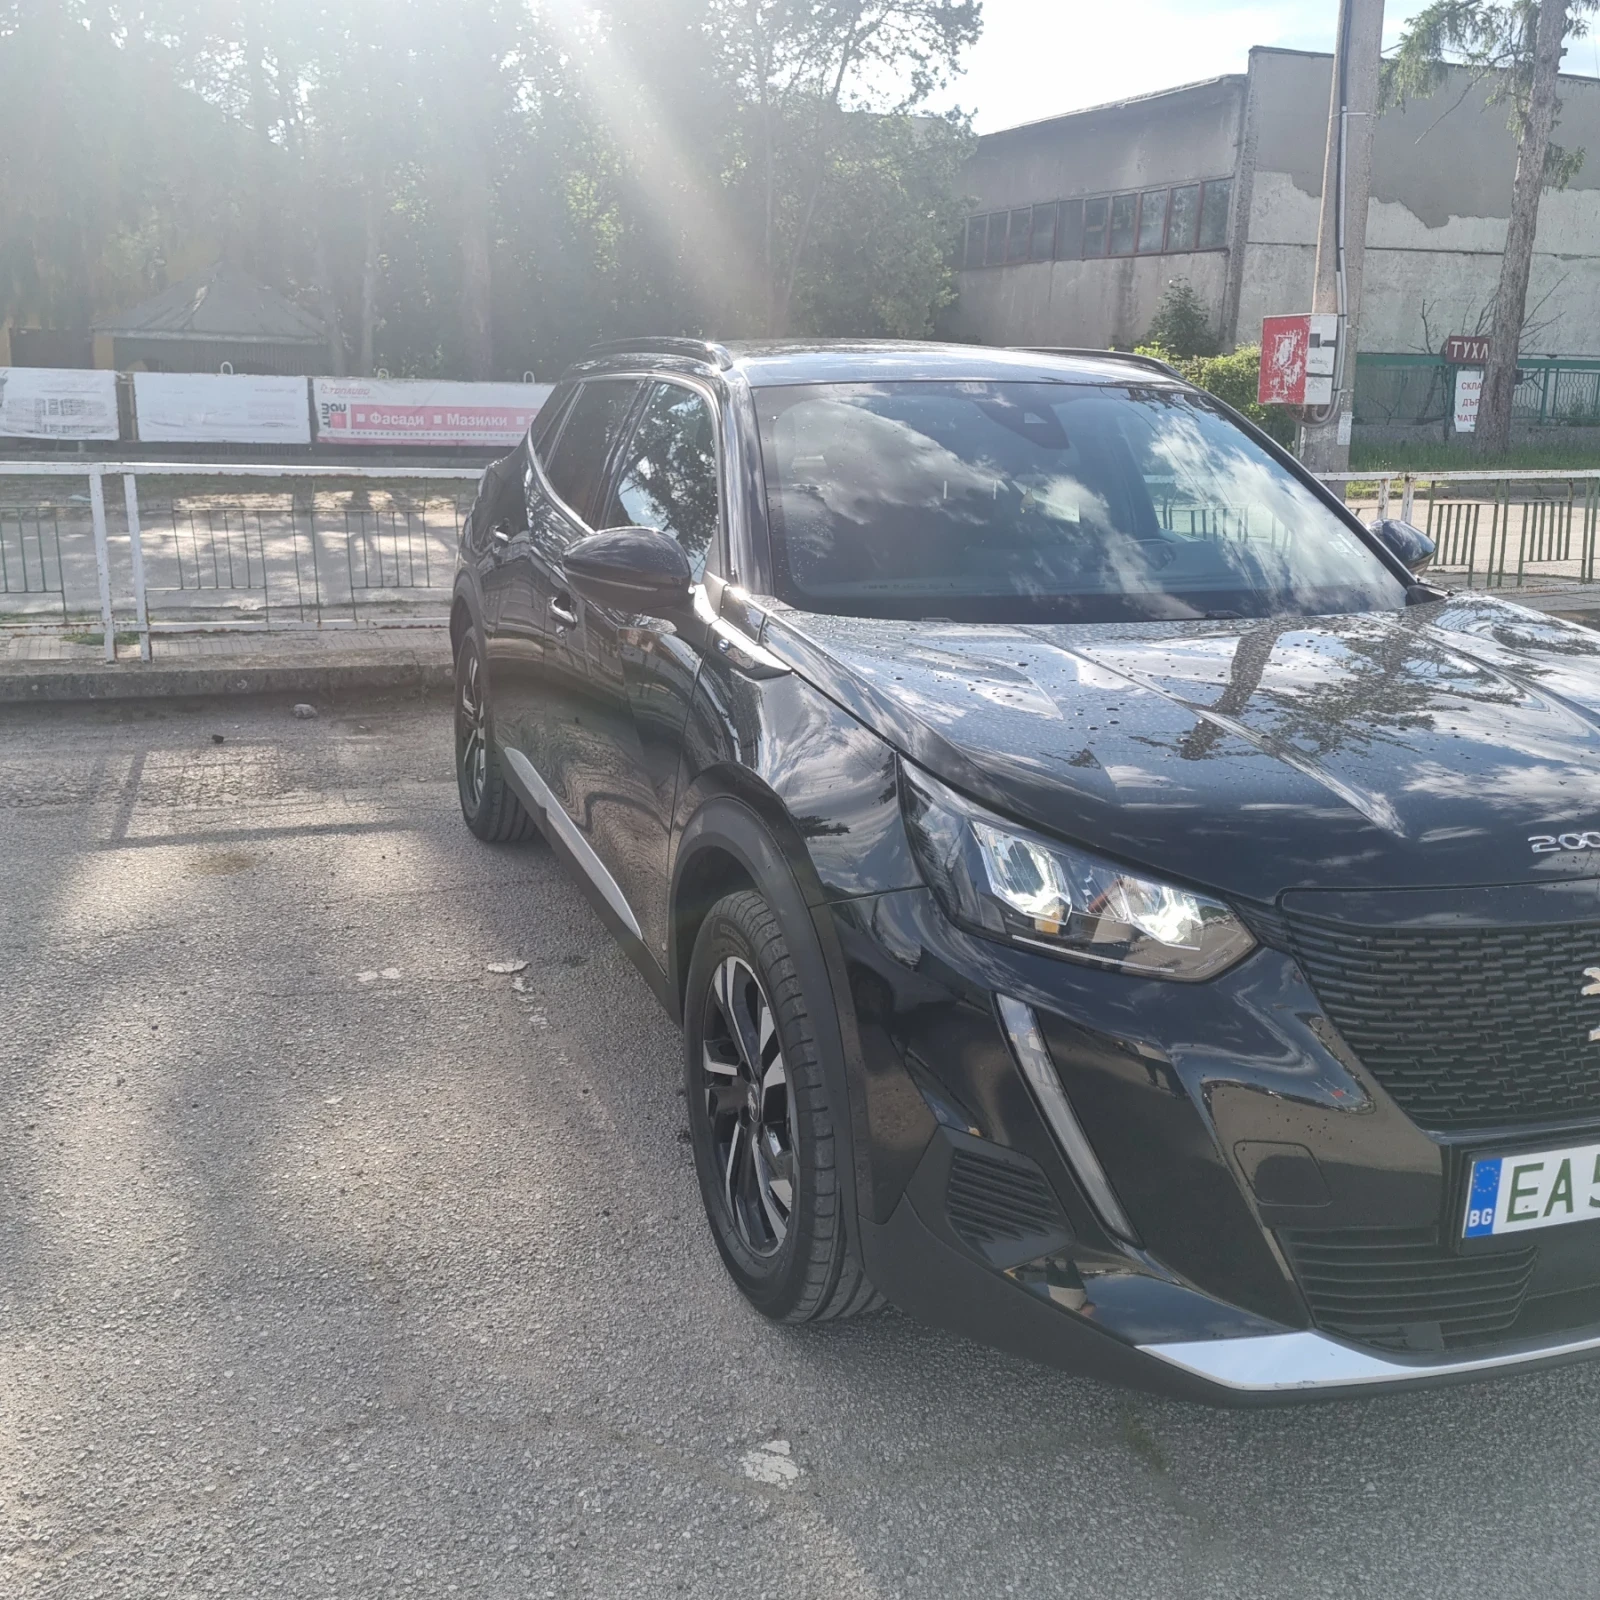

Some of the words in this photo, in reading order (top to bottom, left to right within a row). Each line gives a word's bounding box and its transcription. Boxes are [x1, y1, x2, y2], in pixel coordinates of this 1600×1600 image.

[1450, 341, 1489, 359] ТУХЛ
[369, 412, 425, 426] Фасади
[447, 413, 508, 426] Мазилки
[1468, 1208, 1493, 1228] BG
